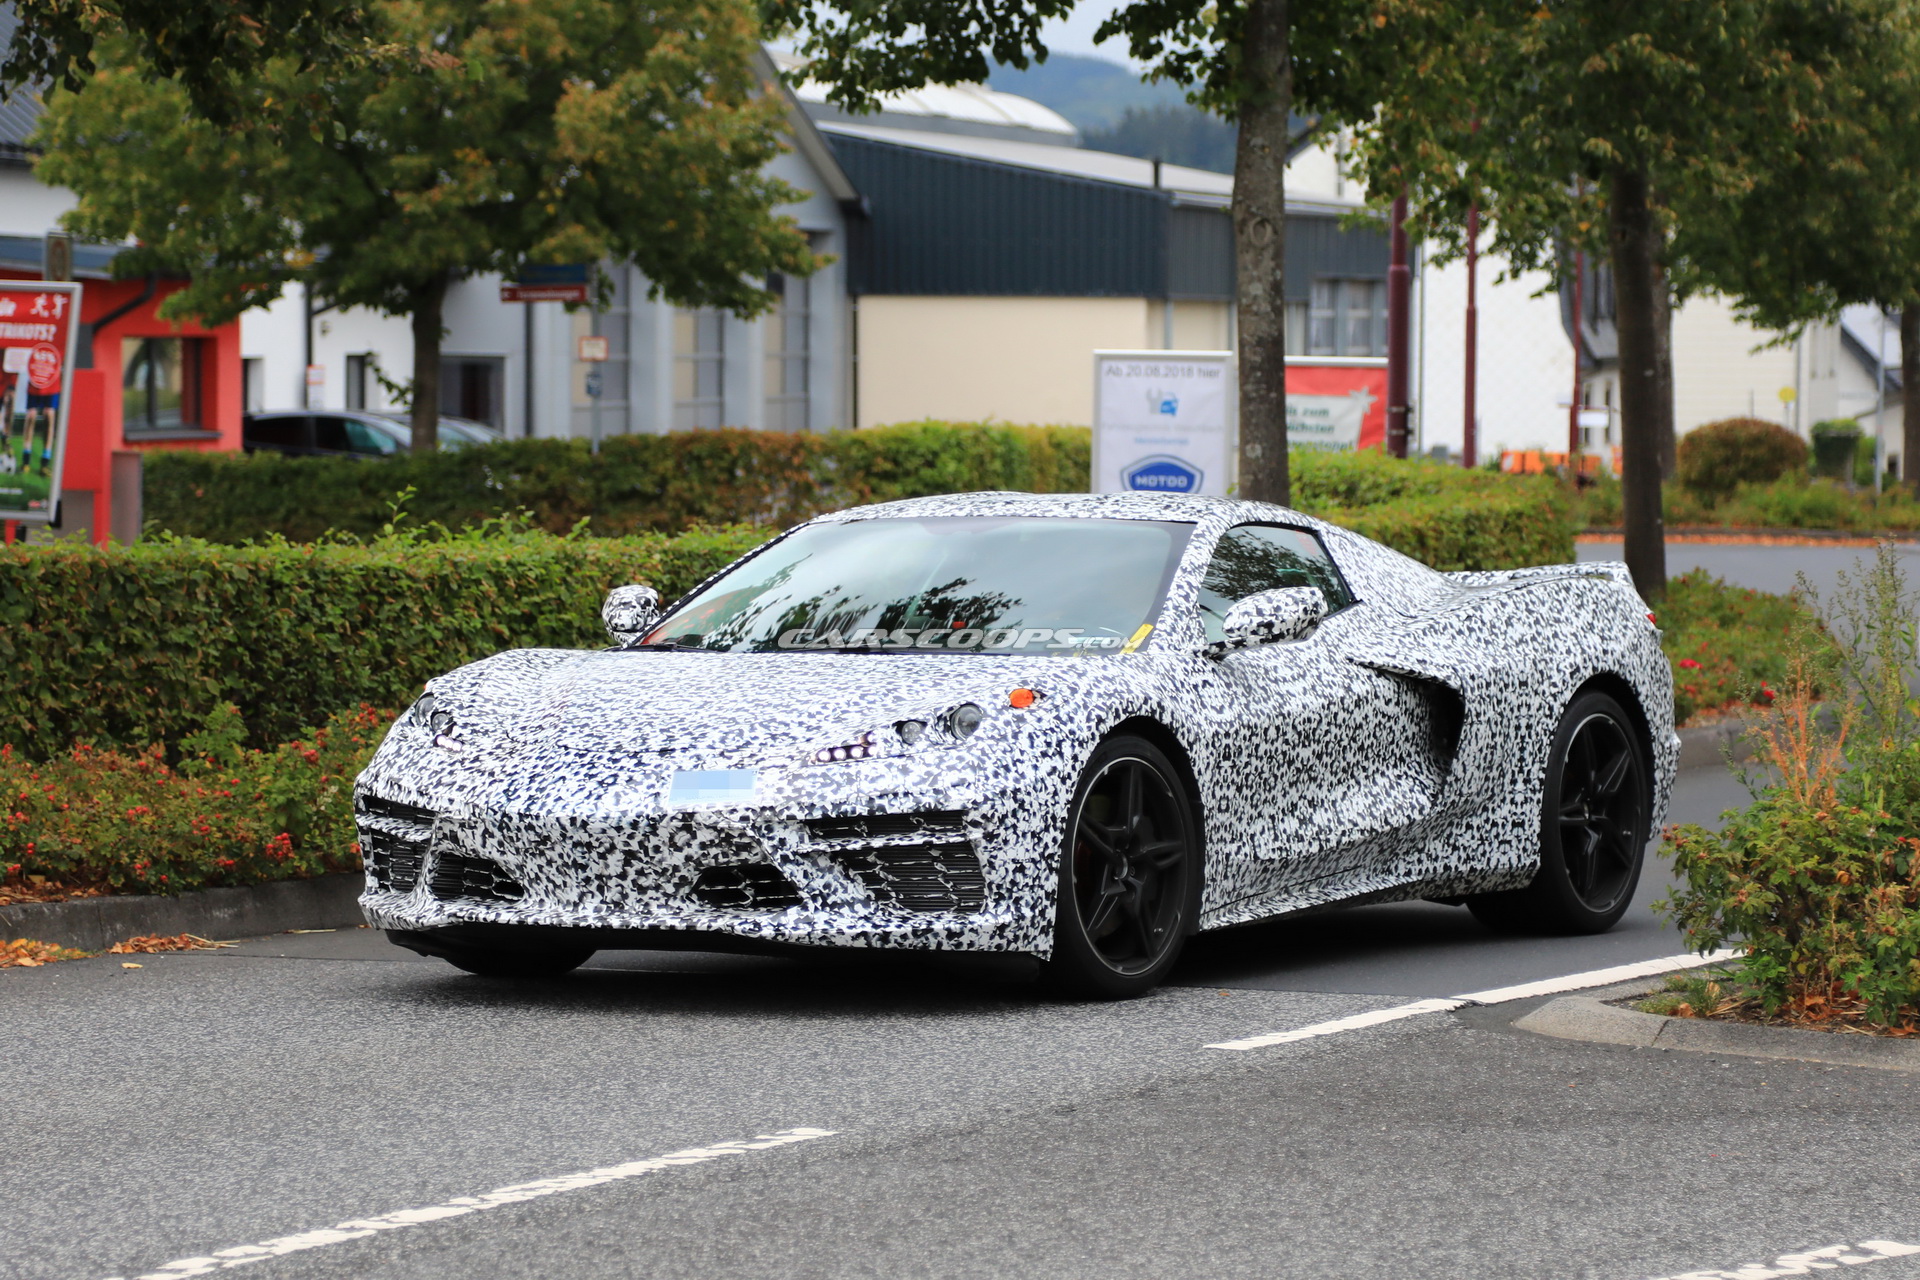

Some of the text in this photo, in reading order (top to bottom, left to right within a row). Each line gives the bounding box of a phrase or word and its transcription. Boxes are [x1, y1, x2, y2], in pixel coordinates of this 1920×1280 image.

[1107, 365, 1220, 378] Ab 20.08.2018 hier
